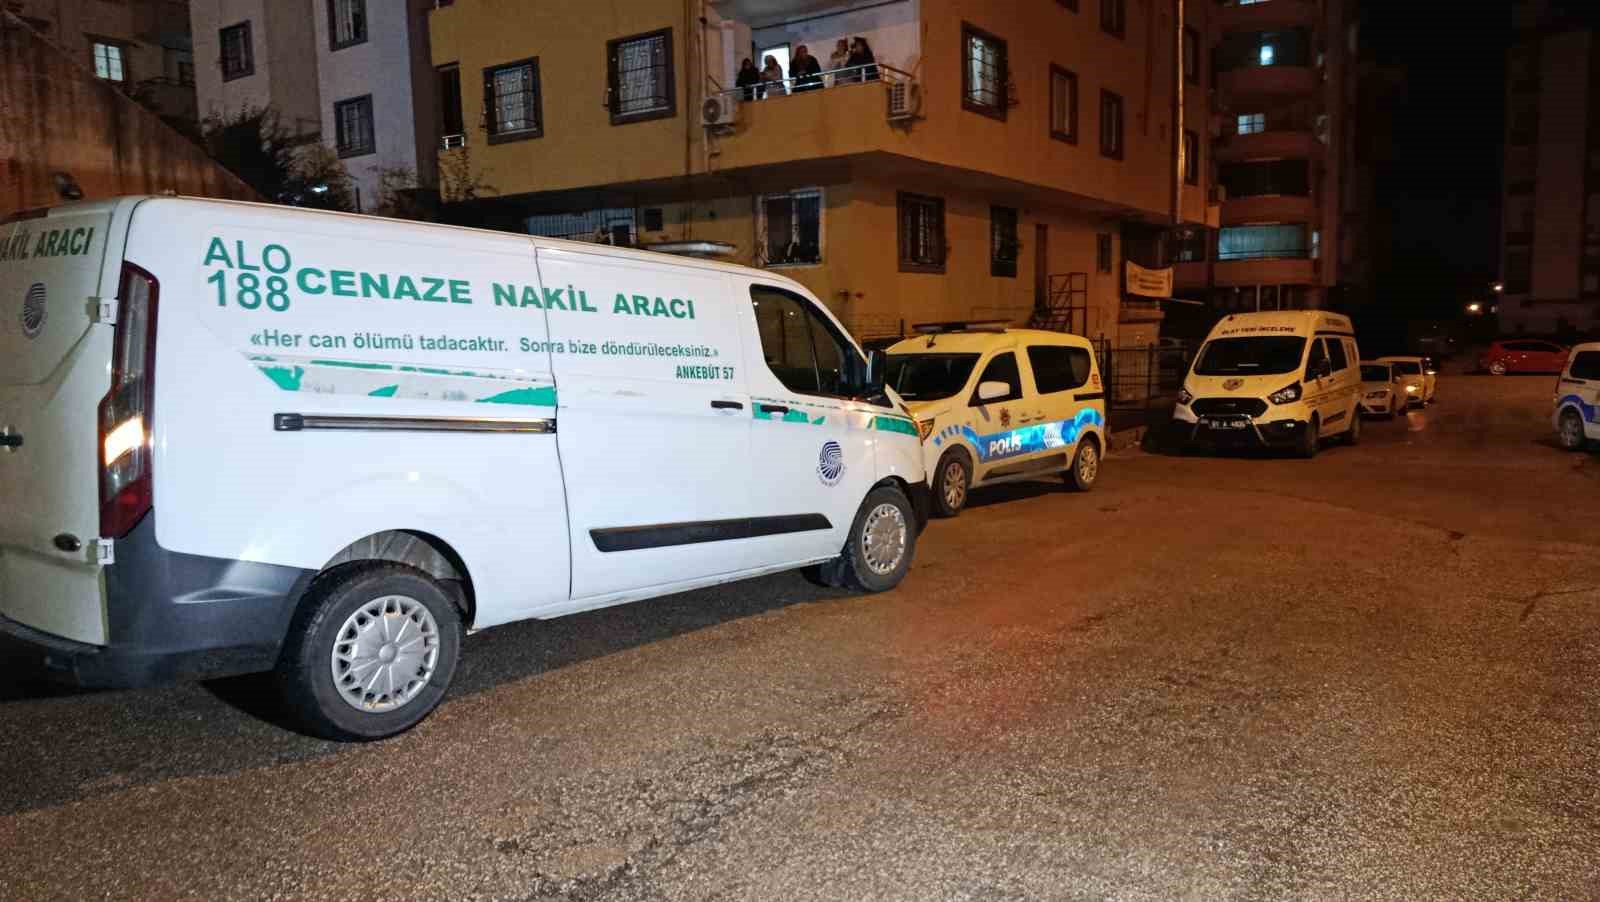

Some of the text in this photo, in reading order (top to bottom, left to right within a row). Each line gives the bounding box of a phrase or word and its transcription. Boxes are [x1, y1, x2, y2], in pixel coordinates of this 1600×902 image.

[33, 227, 94, 257] ARACI
[203, 236, 291, 274] ALO
[207, 269, 290, 312] 188
[296, 267, 696, 319] CENAZE NAKİL ARACI
[309, 334, 346, 348] can
[353, 332, 413, 350] ölümü
[419, 334, 508, 352] tadacaktır.
[520, 337, 565, 353] Sonra
[568, 340, 597, 355] bize
[723, 366, 734, 380] 57
